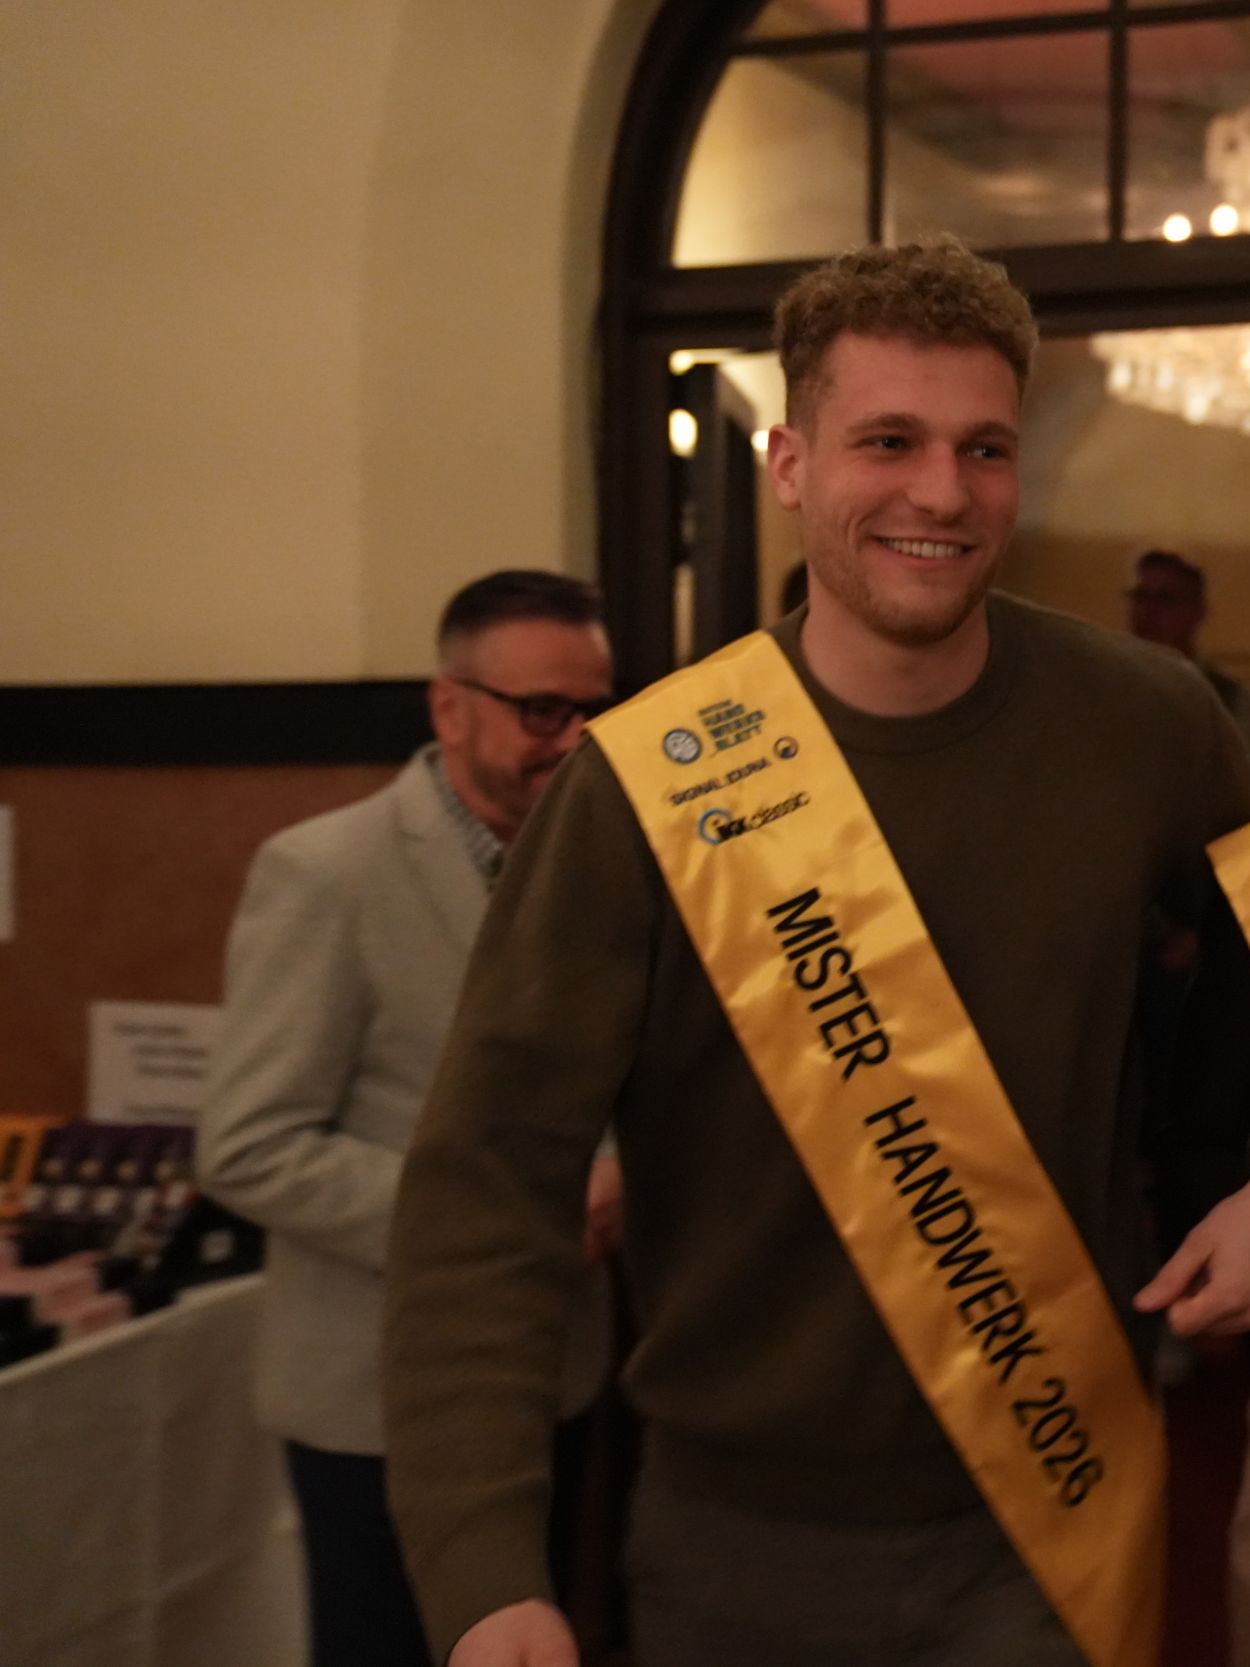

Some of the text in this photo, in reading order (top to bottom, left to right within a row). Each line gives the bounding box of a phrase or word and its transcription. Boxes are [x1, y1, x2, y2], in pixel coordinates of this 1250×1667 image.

[766, 886, 1105, 1509] MISTER HANDWERK 2026
